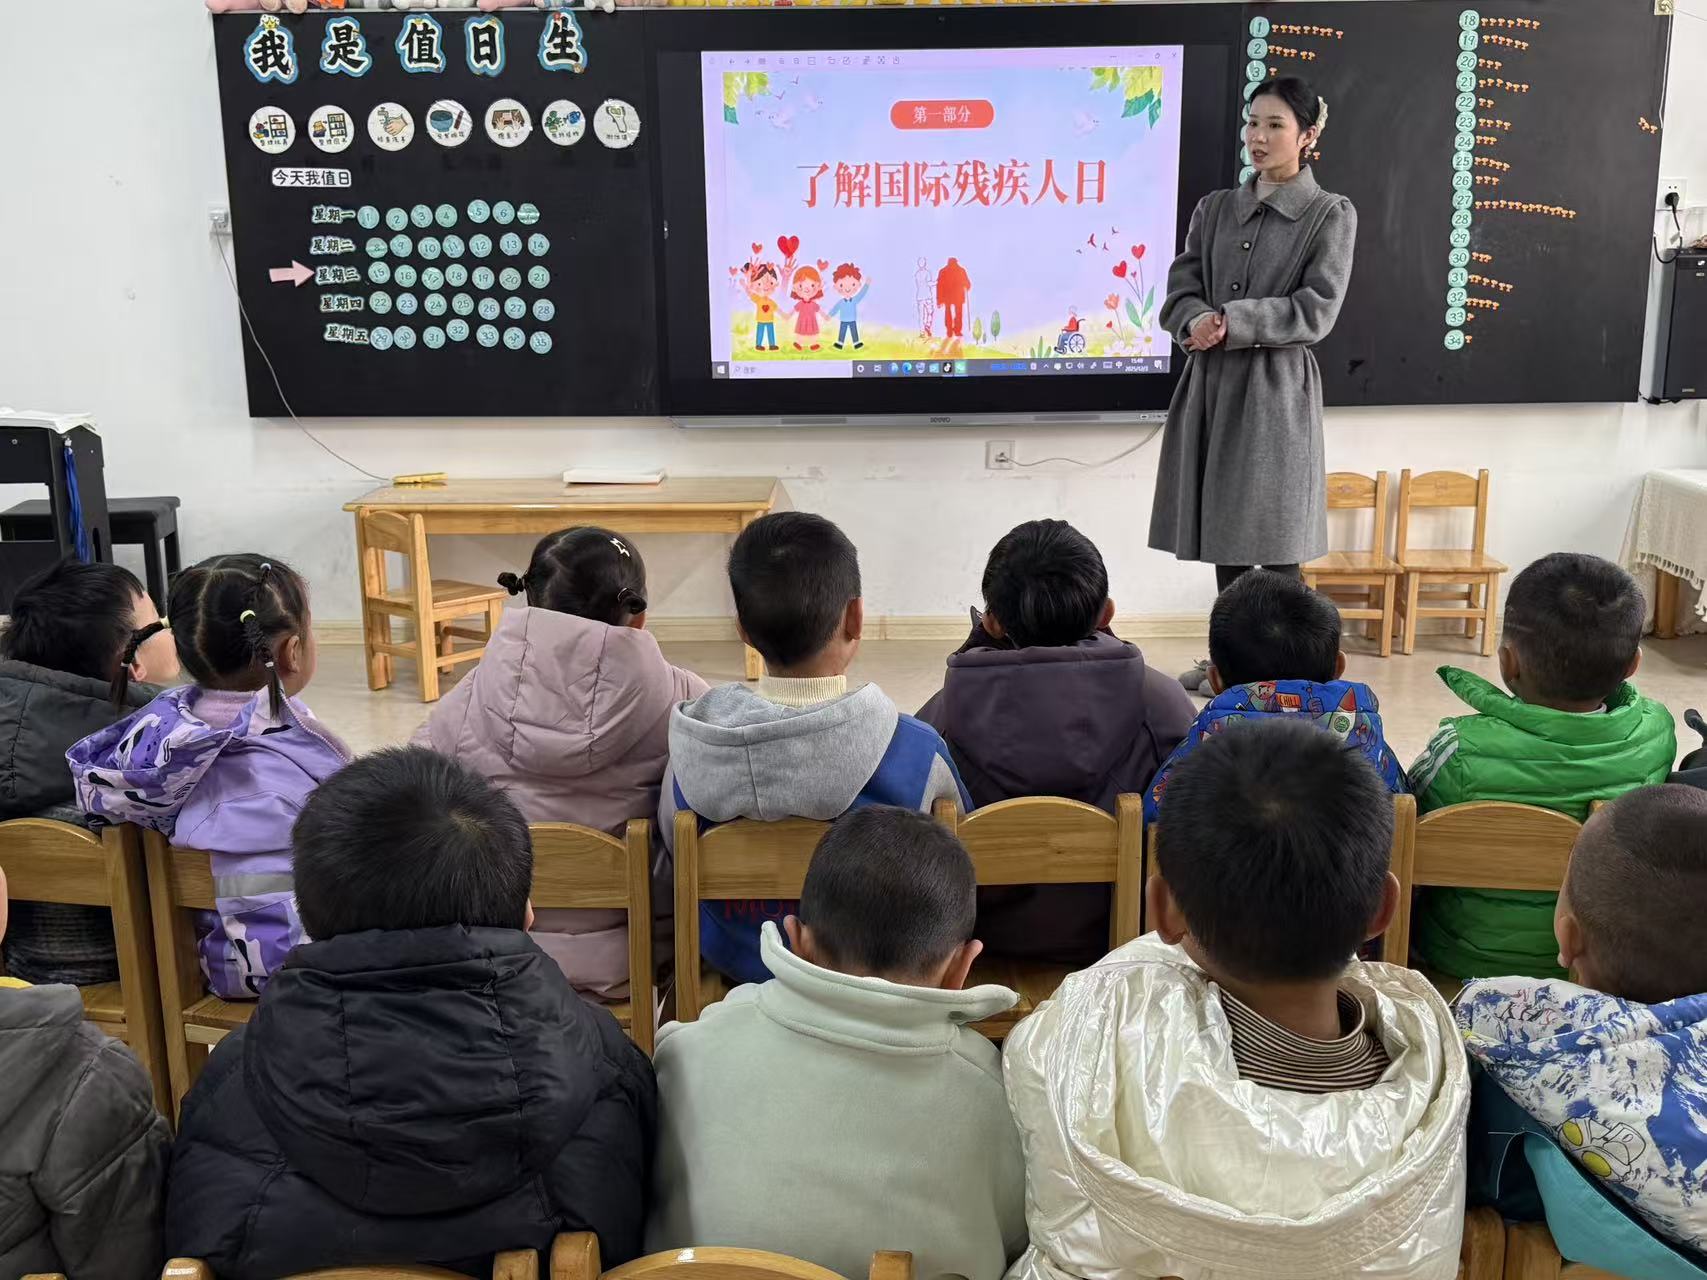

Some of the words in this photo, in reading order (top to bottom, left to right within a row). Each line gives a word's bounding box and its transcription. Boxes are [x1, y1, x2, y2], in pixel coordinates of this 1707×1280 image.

[1464, 14, 1476, 25] 18
[252, 17, 581, 75] 我是值日生
[1463, 35, 1475, 46] 19
[1460, 56, 1475, 68] 20
[1461, 76, 1473, 87] 21
[1459, 96, 1472, 107] 22
[913, 104, 972, 124] 第一部分
[1459, 117, 1473, 128] 23
[1458, 137, 1472, 147] 24
[1456, 156, 1470, 167] 25
[273, 169, 350, 186] 今天我值日
[796, 158, 1106, 208] 了解国际残疾人日
[1455, 175, 1469, 186] 26
[1457, 195, 1471, 206] 27
[313, 207, 354, 222] 星期一
[393, 215, 401, 224] 2
[418, 212, 426, 221] 3
[443, 211, 450, 220] 4
[475, 207, 483, 216] 5
[500, 208, 507, 218] 6
[1454, 214, 1469, 225] 28
[1453, 233, 1468, 243] 29
[312, 238, 354, 252] 星期二
[424, 244, 436, 253] 10
[448, 242, 458, 252] 11
[475, 241, 487, 251] 12
[506, 240, 517, 249] 13
[533, 241, 544, 250] 14
[1452, 253, 1467, 264] 30
[318, 267, 359, 282] 星期三
[373, 268, 385, 278] 15
[400, 271, 412, 280] 16
[427, 273, 440, 283] 17
[451, 271, 462, 281] 18
[478, 273, 489, 283] 19
[505, 274, 518, 285] 20
[534, 273, 545, 282] 21
[1451, 272, 1465, 283] 31
[1450, 291, 1464, 303] 32
[322, 296, 362, 310] 星期四
[374, 298, 387, 307] 22
[401, 299, 414, 308] 23
[429, 301, 442, 310] 24
[457, 300, 470, 309] 25
[483, 304, 496, 313] 26
[510, 303, 522, 313] 27
[537, 305, 550, 314] 28
[1449, 312, 1464, 322] 33
[327, 325, 368, 342] 星期五
[375, 333, 388, 343] 29
[399, 331, 411, 344] 30
[428, 333, 439, 342] 31
[451, 326, 464, 335] 32
[482, 331, 495, 340] 33
[508, 332, 520, 345] 34
[534, 338, 547, 347] 35
[1447, 335, 1461, 346] 34
